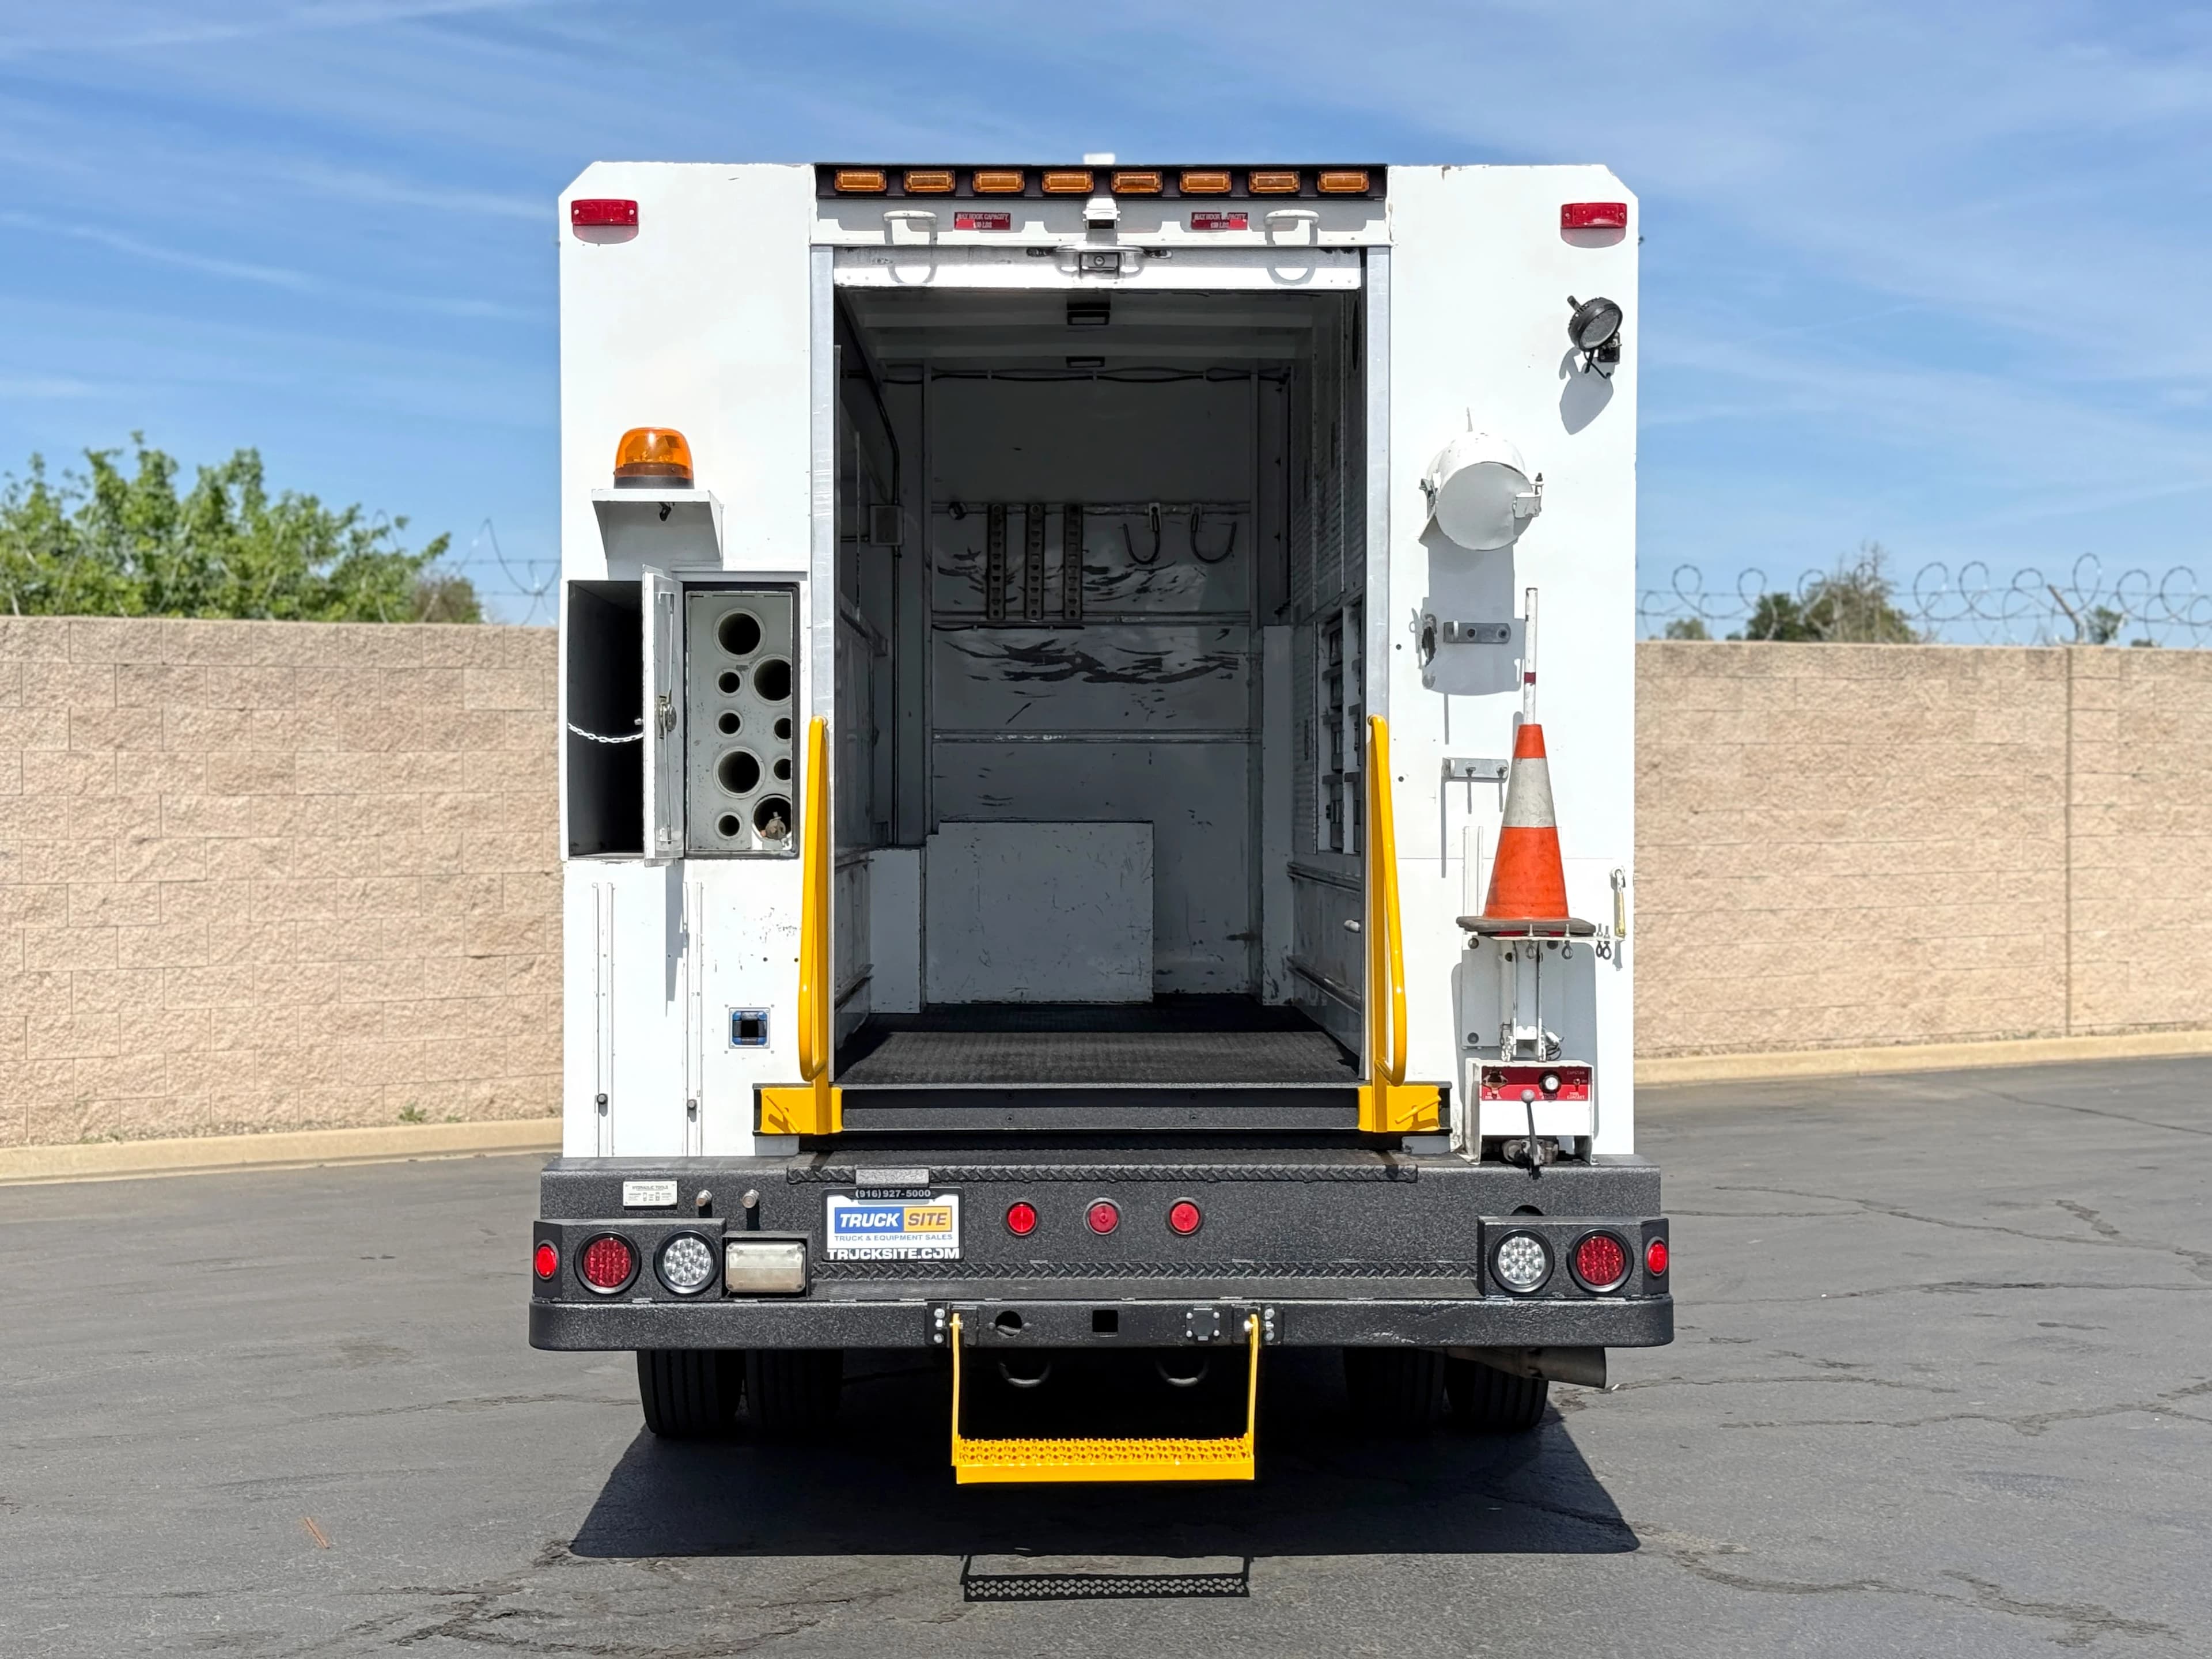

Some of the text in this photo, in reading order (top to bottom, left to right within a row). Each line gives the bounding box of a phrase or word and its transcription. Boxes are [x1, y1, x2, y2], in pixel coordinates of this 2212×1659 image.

[840, 1212, 948, 1228] TRUCK SITE
[827, 1247, 960, 1260] TRUCKSITE.COM
